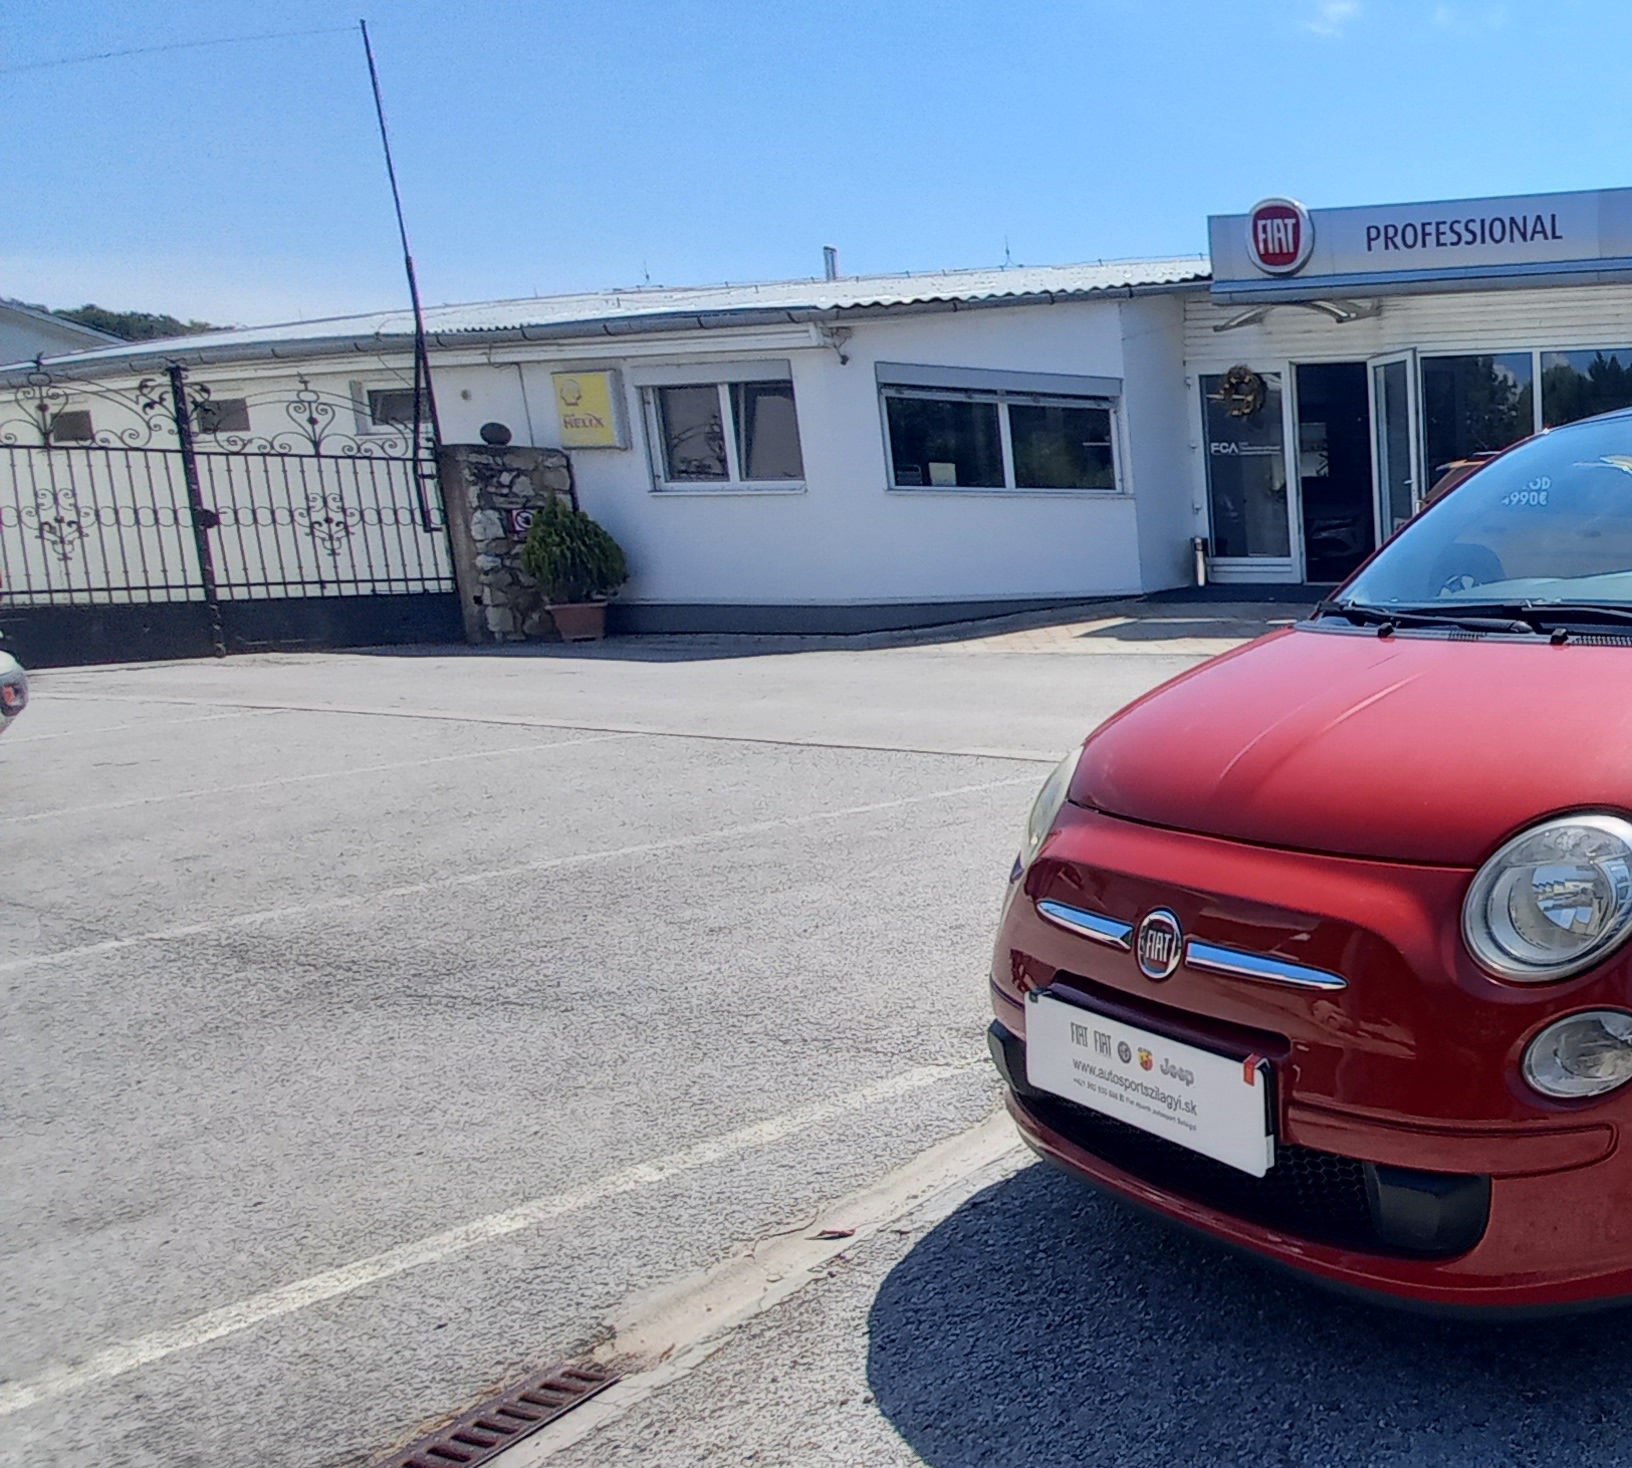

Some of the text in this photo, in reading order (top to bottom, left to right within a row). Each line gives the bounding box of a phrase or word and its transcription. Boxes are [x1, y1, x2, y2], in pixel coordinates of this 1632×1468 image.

[1257, 218, 1297, 254] FIAT
[1366, 213, 1564, 252] PROFESSIONAL
[1210, 442, 1239, 454] FCA
[1145, 929, 1172, 963] FIAT
[1070, 1021, 1195, 1087] FIAT FIAT Jeep
[1072, 1058, 1198, 1117] www.autosportszilagyi.sk
